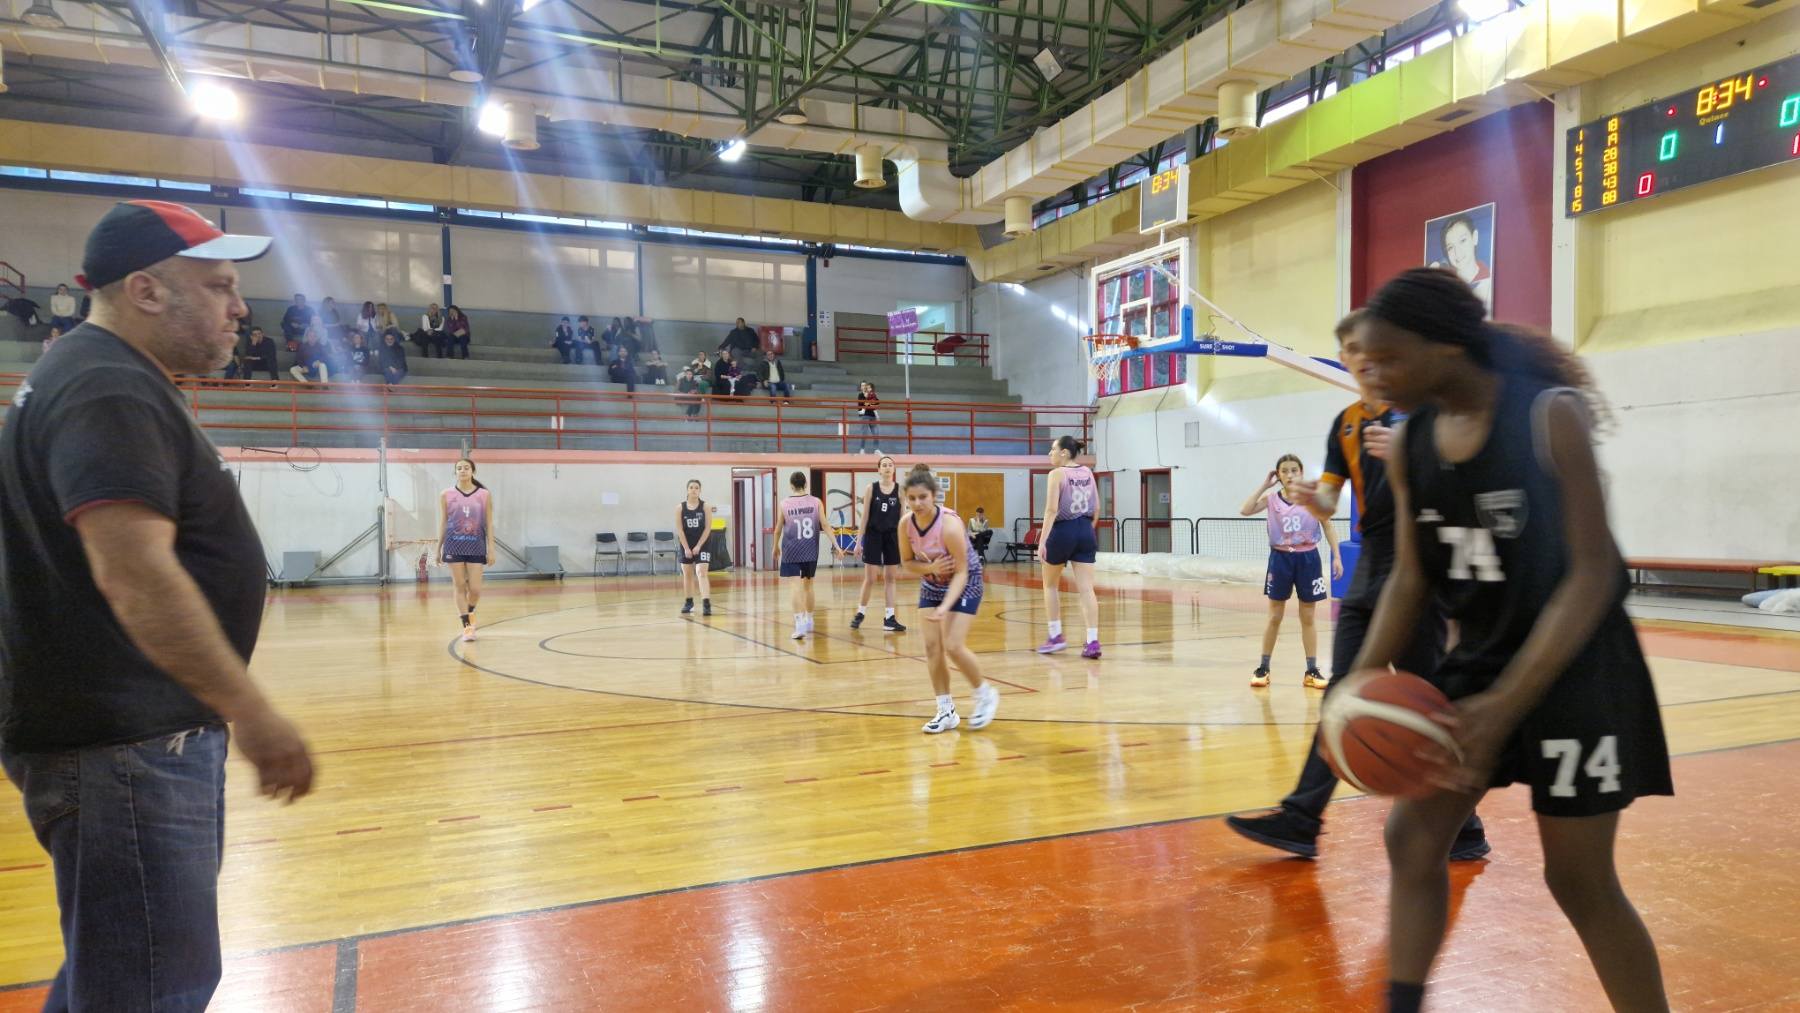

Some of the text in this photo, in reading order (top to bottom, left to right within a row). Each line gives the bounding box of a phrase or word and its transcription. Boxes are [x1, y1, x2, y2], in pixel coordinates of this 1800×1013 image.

[1696, 74, 1753, 116] 8:34
[1779, 96, 1799, 127] 0
[1715, 121, 1724, 144] 1
[1575, 143, 1583, 155] 4
[1659, 132, 1677, 161] 0
[1575, 157, 1583, 171] 5
[1151, 168, 1178, 194] 8:34
[1575, 171, 1583, 183] 7
[1638, 174, 1652, 194] 0
[1574, 184, 1582, 198] 8
[462, 506, 470, 518] 4
[687, 518, 699, 528] 69
[793, 516, 814, 540] 18
[1282, 515, 1301, 533] 28
[1437, 526, 1507, 581] 74
[1311, 577, 1327, 596] 28
[1540, 735, 1622, 797] 74
